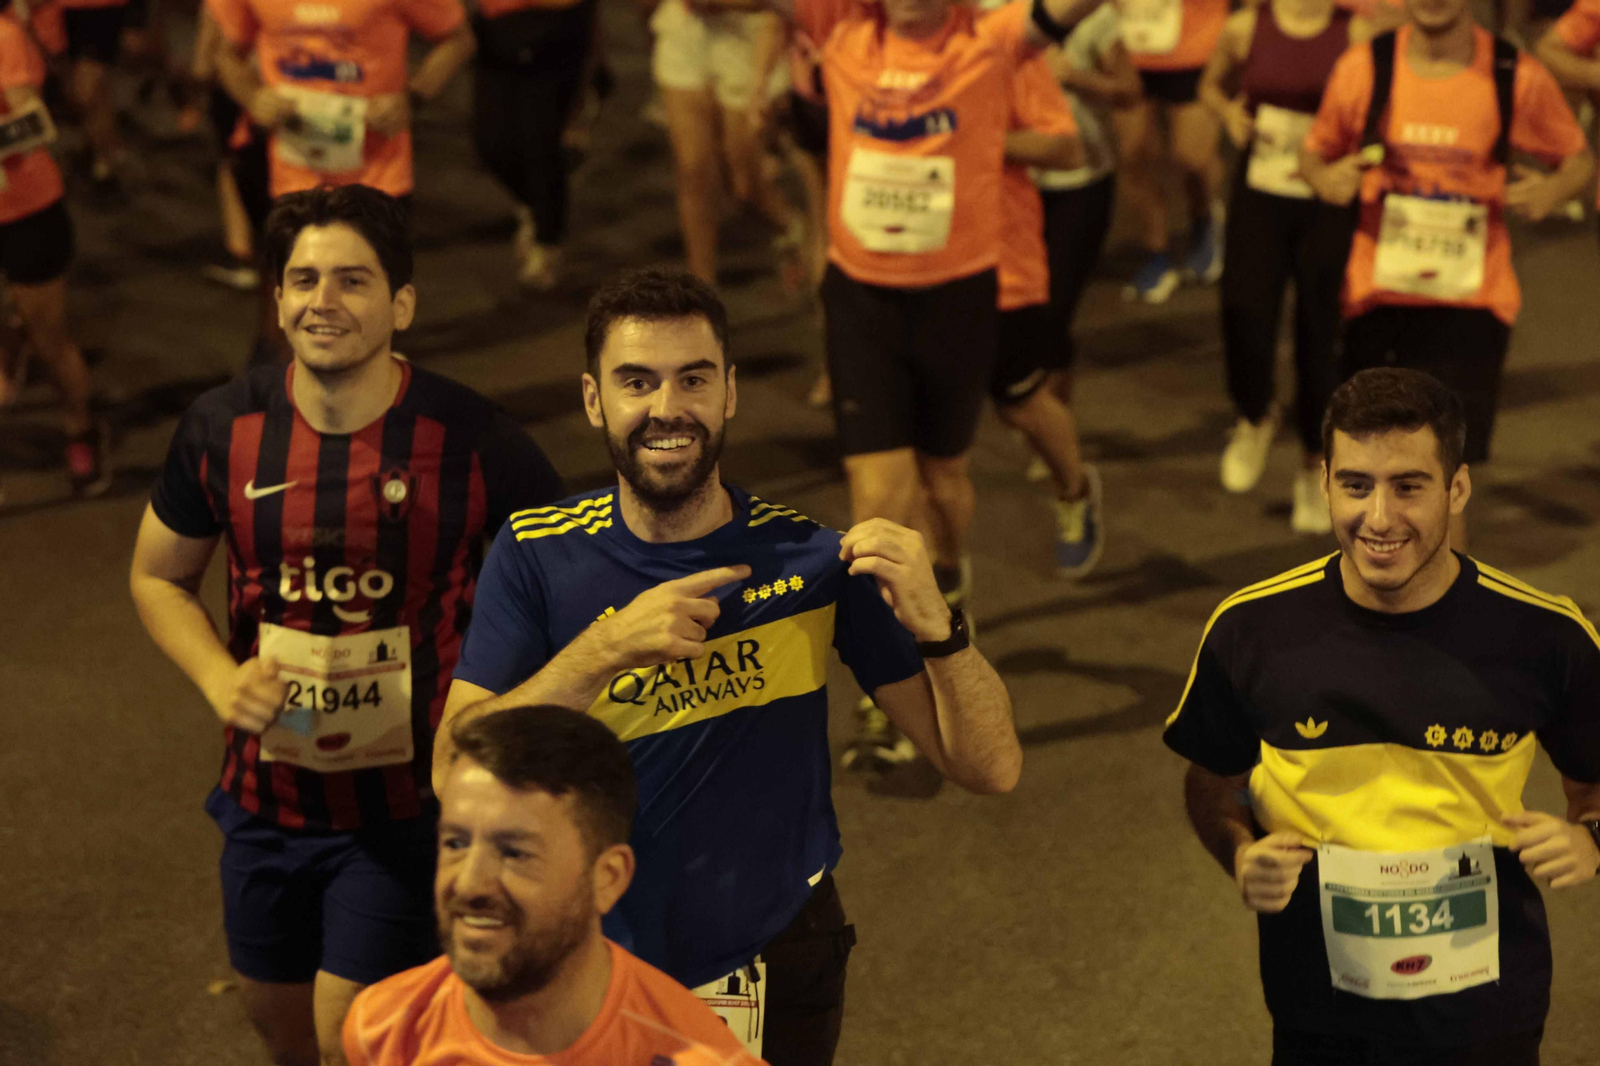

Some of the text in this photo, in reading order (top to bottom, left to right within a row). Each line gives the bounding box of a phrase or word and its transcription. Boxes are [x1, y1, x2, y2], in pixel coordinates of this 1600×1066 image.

[279, 556, 393, 622] tigo
[608, 639, 764, 706] QATAR
[654, 671, 765, 716] AIRWAYS
[287, 680, 382, 714] 21944
[1364, 899, 1454, 935] 1134
